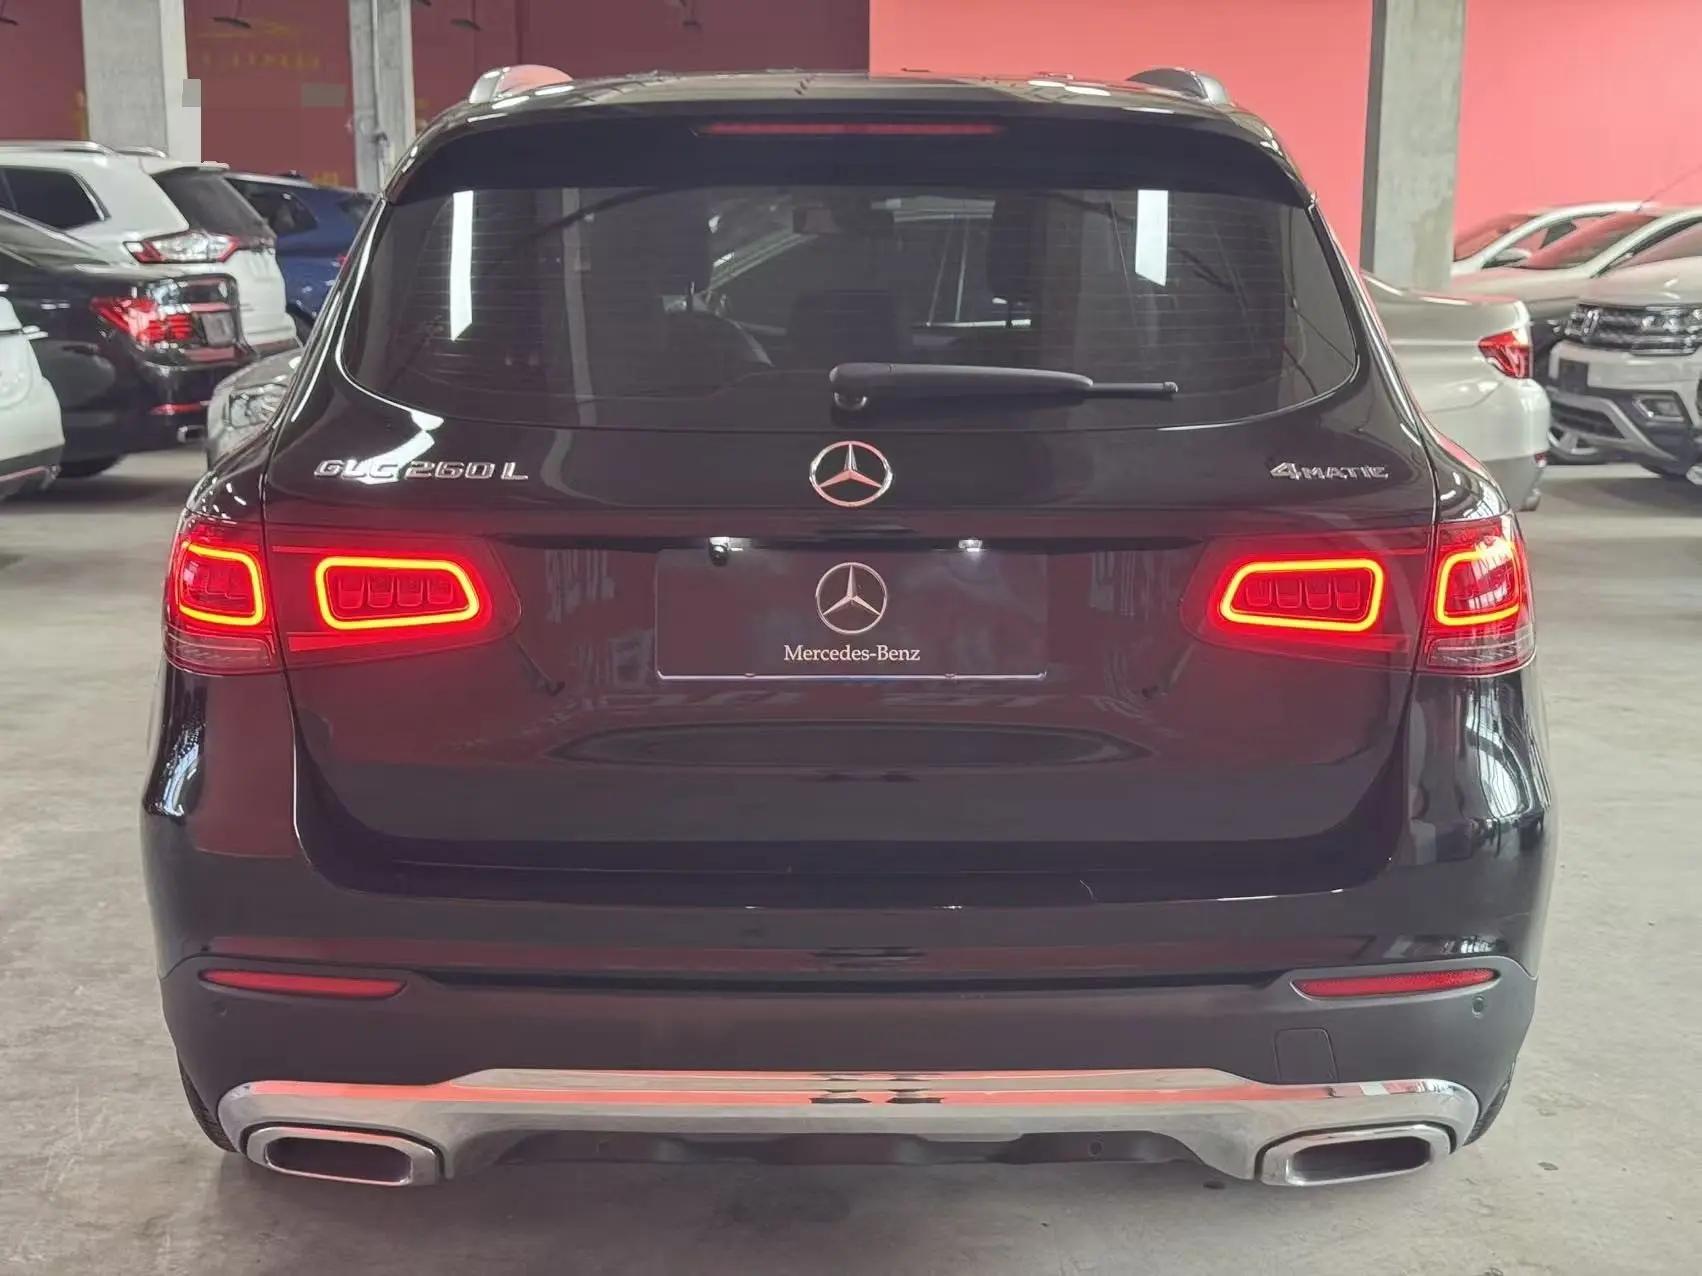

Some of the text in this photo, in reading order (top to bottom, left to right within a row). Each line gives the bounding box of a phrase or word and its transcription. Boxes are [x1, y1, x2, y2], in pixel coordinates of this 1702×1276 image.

[313, 459, 529, 480] GLC 260 L
[1270, 462, 1389, 480] 4MATIC
[783, 644, 921, 662] Mercedes-Benz
